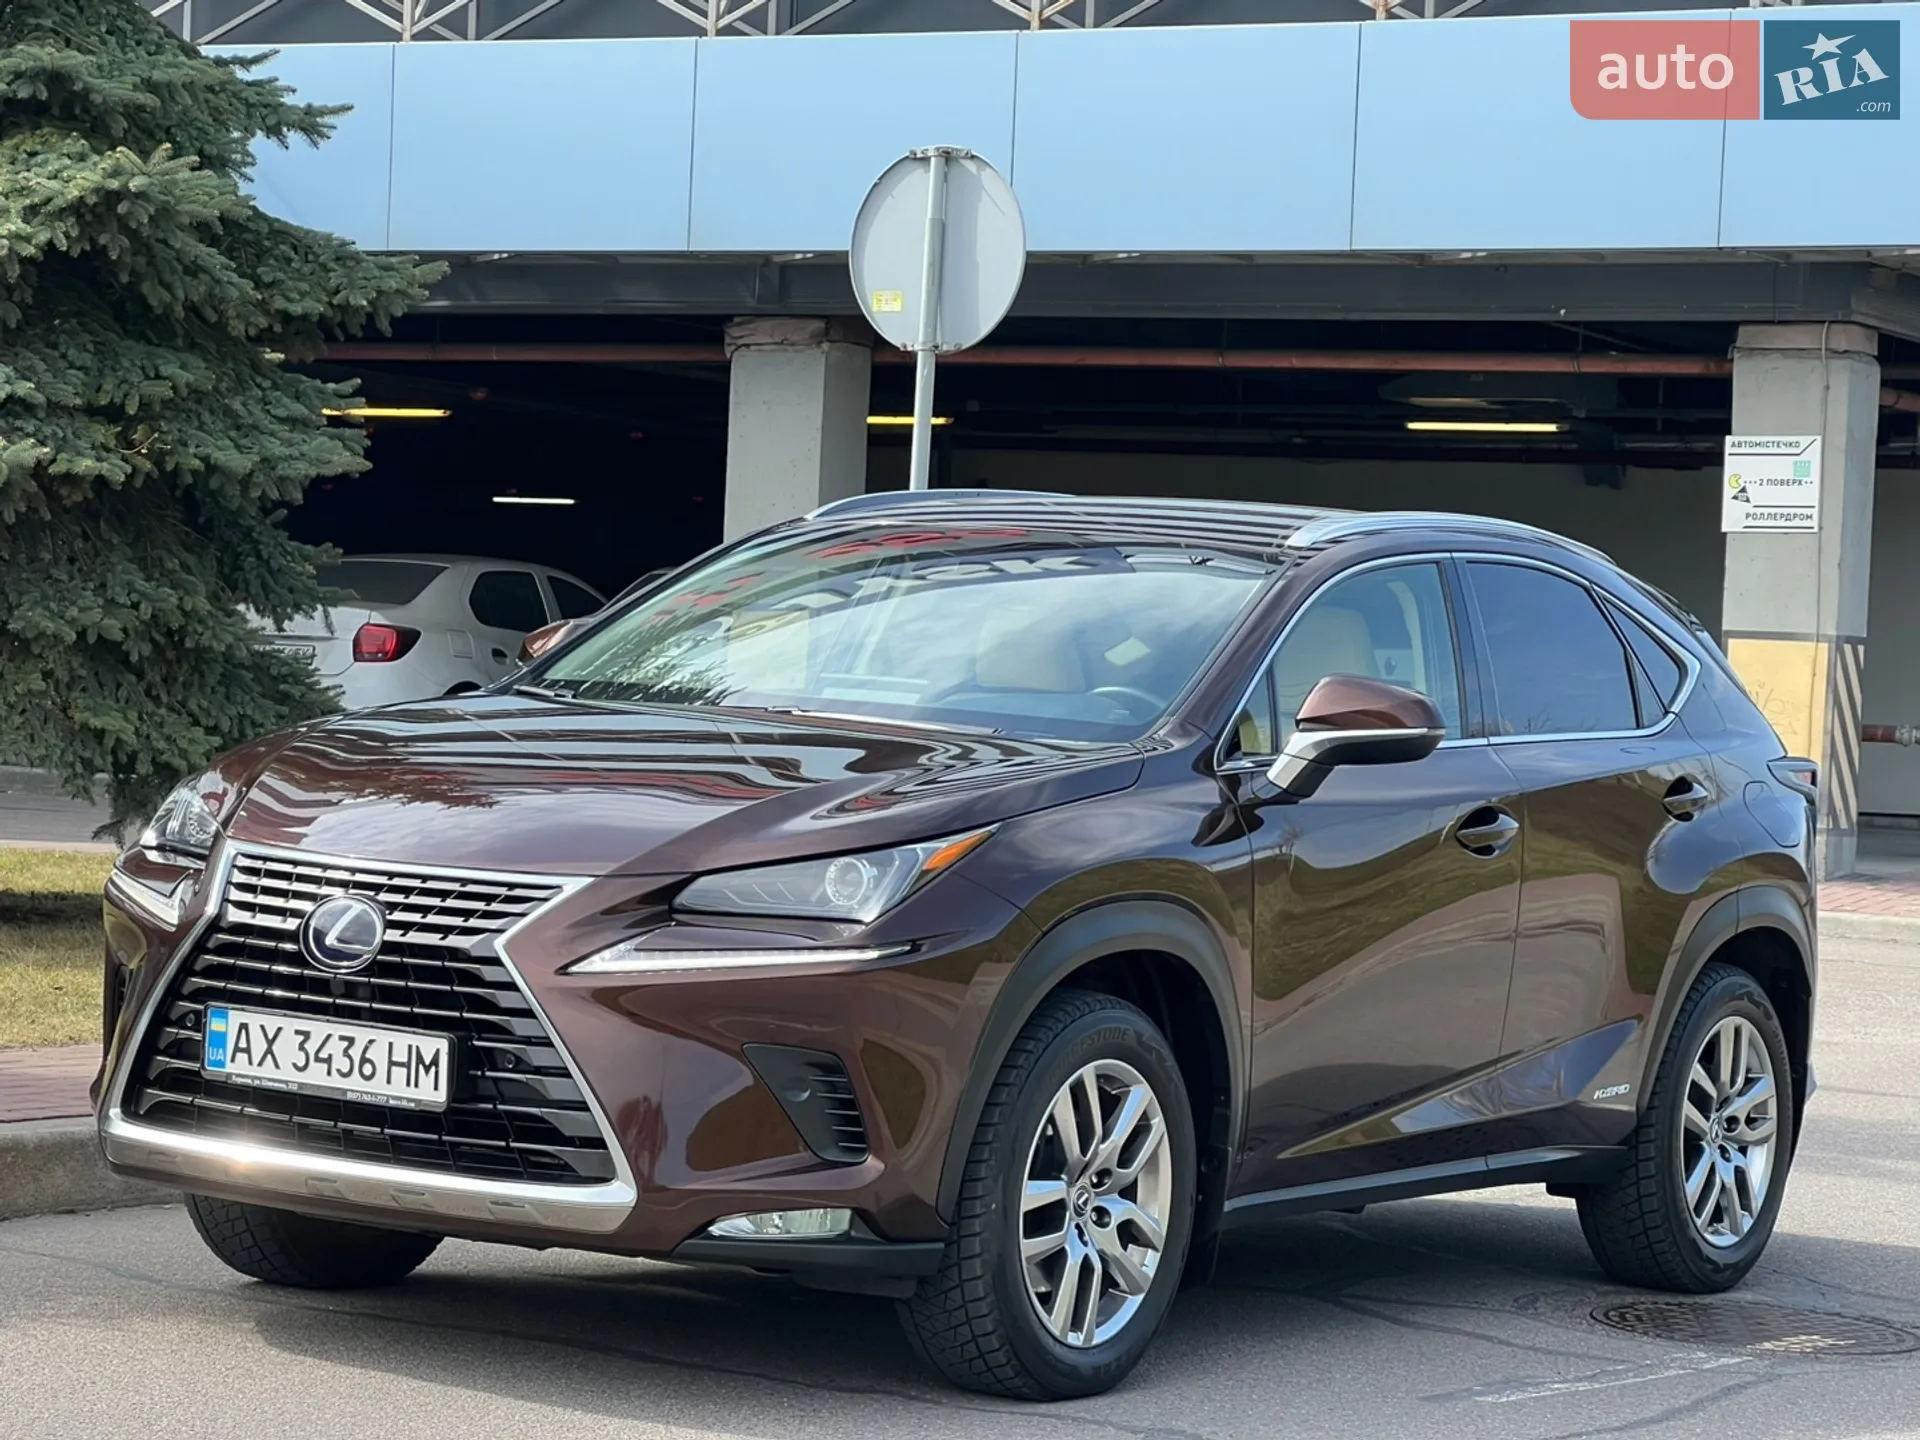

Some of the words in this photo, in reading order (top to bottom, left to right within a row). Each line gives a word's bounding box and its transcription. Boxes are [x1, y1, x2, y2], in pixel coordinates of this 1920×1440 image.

[1730, 440, 1801, 448] АВТОМІСТЕЧКО
[1758, 478, 1764, 487] 2
[1766, 478, 1804, 487] ПОВЕРХ
[1745, 512, 1814, 522] РОЛЛЕРДРОМ
[208, 1048, 225, 1062] UA
[230, 1022, 284, 1071] AX
[290, 1029, 378, 1082] 3436
[386, 1041, 442, 1092] HM
